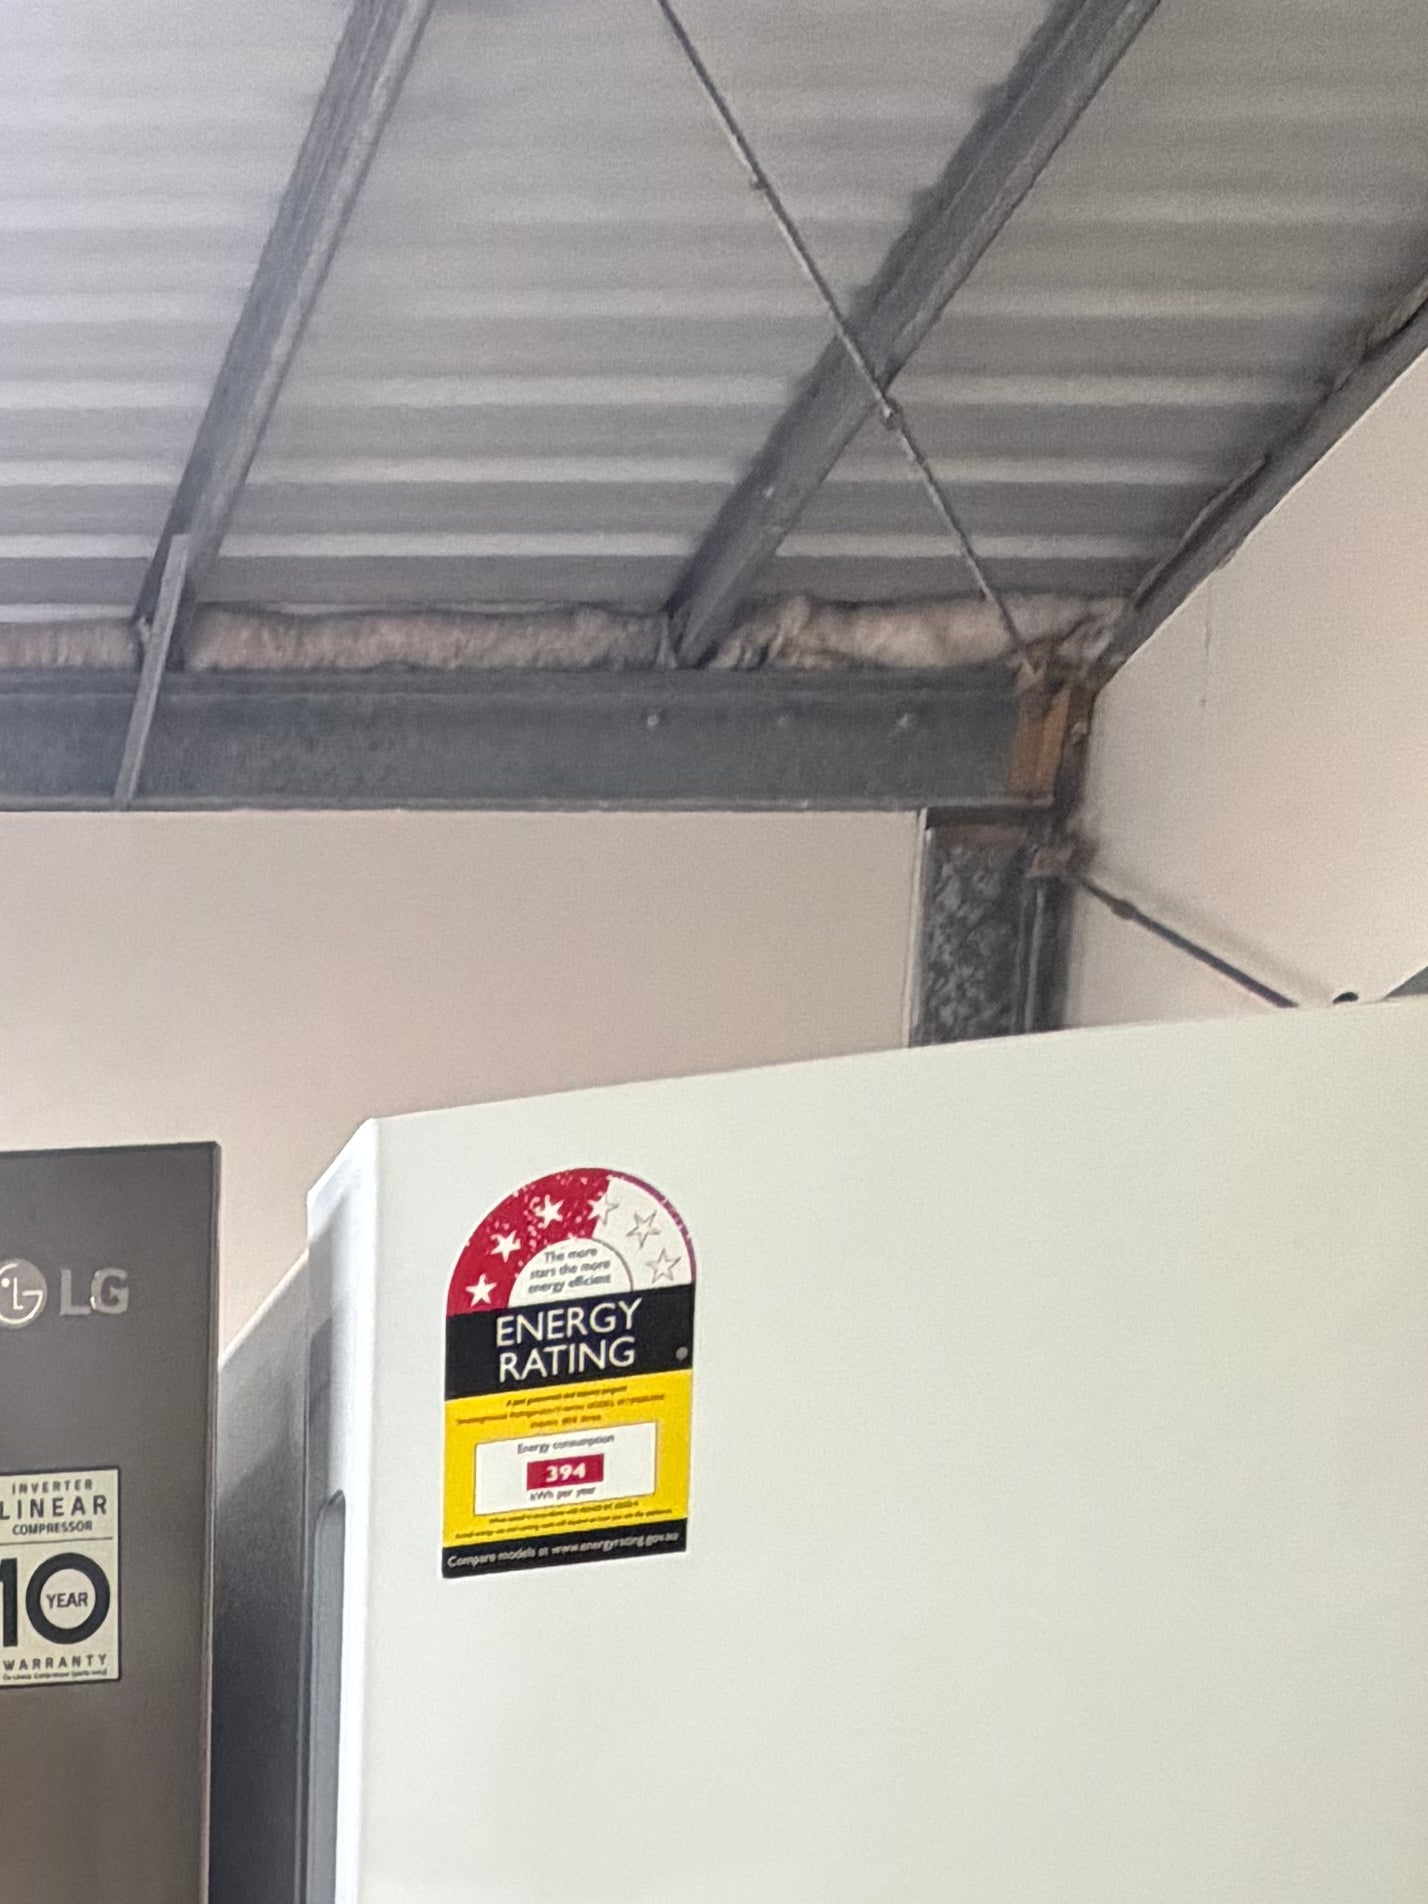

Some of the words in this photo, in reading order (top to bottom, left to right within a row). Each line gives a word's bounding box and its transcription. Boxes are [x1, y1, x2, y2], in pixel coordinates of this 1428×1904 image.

[544, 1251, 565, 1264] The
[567, 1248, 598, 1260] more
[530, 1268, 556, 1280] stars
[559, 1263, 577, 1275] the
[580, 1260, 611, 1271] more
[59, 1267, 129, 1316] LG
[528, 1281, 565, 1294] energy
[567, 1274, 611, 1288] efficient
[496, 1297, 643, 1348] ENERGY
[499, 1336, 636, 1383] RATING
[517, 1442, 550, 1454] Energy
[553, 1434, 614, 1450] consumption
[546, 1463, 586, 1483] 394
[12, 1479, 92, 1495] INVERTER
[0, 1494, 107, 1520] LINEAR
[12, 1520, 93, 1535] COMPRESSOR
[46, 1592, 89, 1609] YEAR
[3, 1653, 107, 1671] WARRANTY
